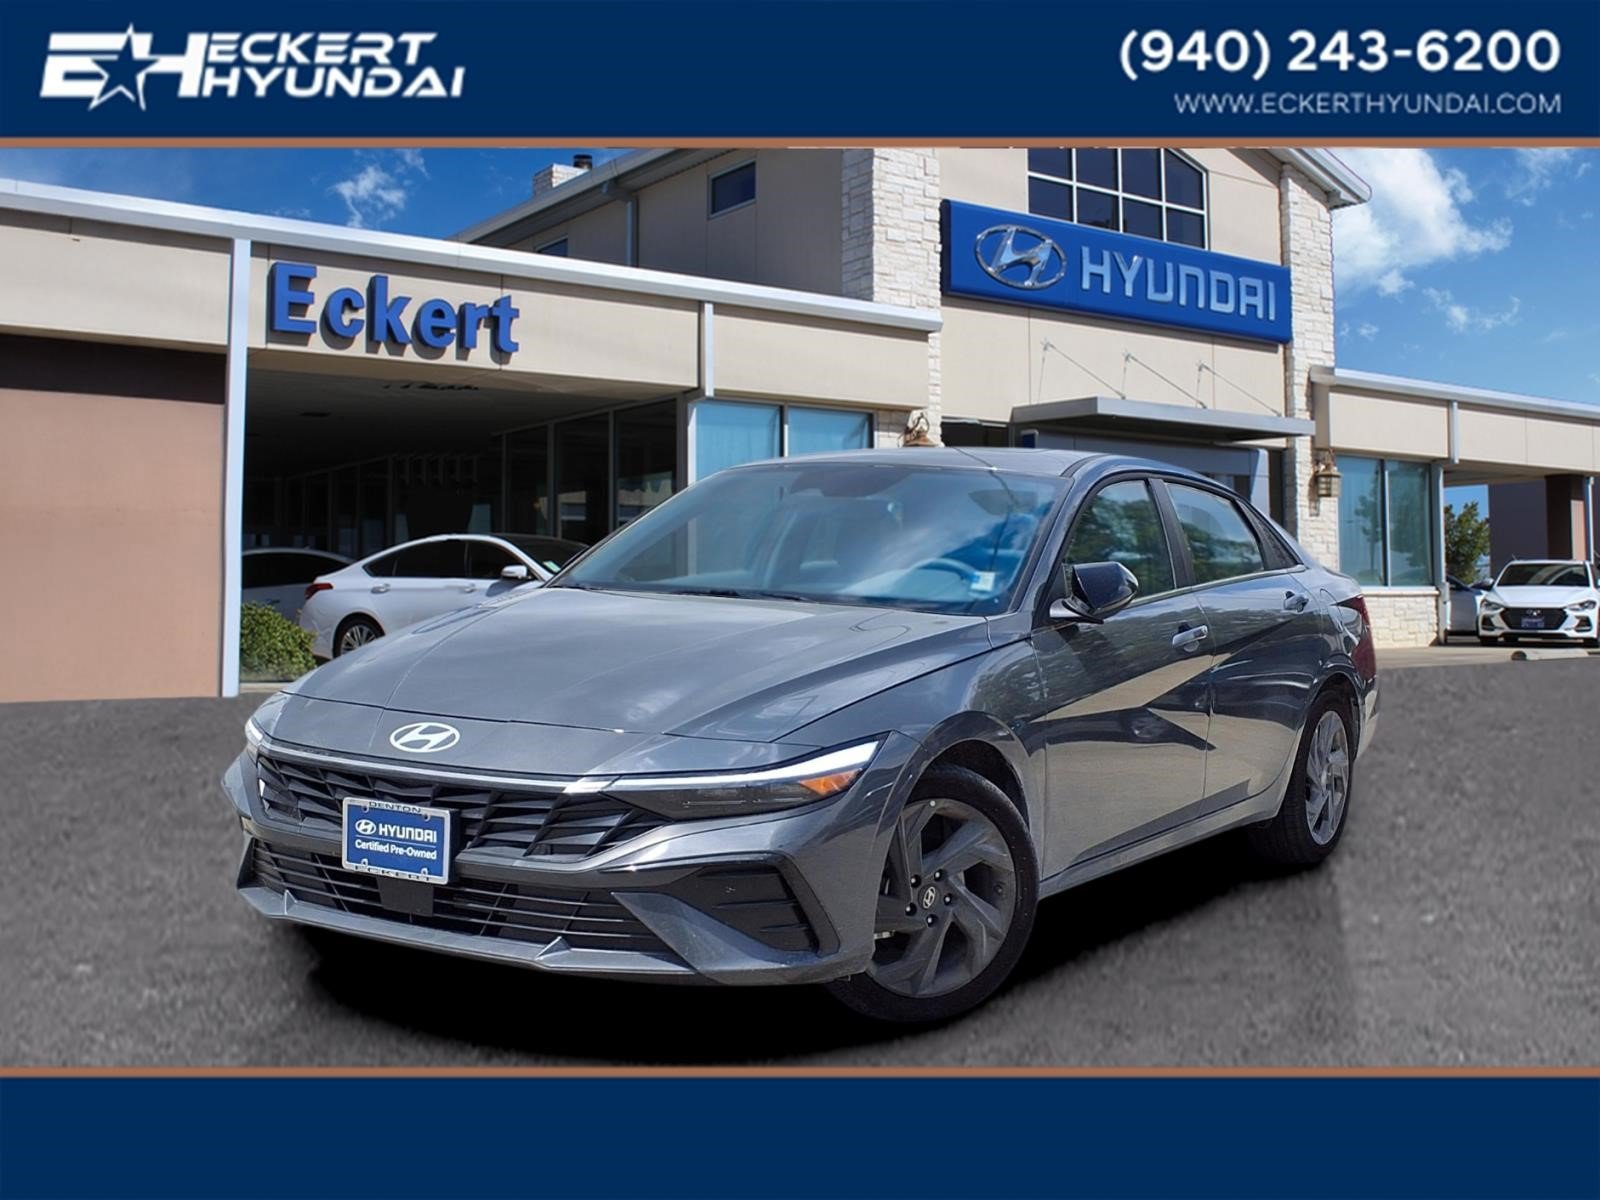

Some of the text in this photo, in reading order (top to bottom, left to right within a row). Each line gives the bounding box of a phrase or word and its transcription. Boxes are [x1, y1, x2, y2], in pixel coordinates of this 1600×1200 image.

[1081, 245, 1276, 321] HYUNDAI
[269, 261, 520, 353] Eckert
[368, 801, 422, 814] DENTON
[379, 823, 438, 843] HYUNDAI
[355, 839, 437, 860] Certified Pre-Owned
